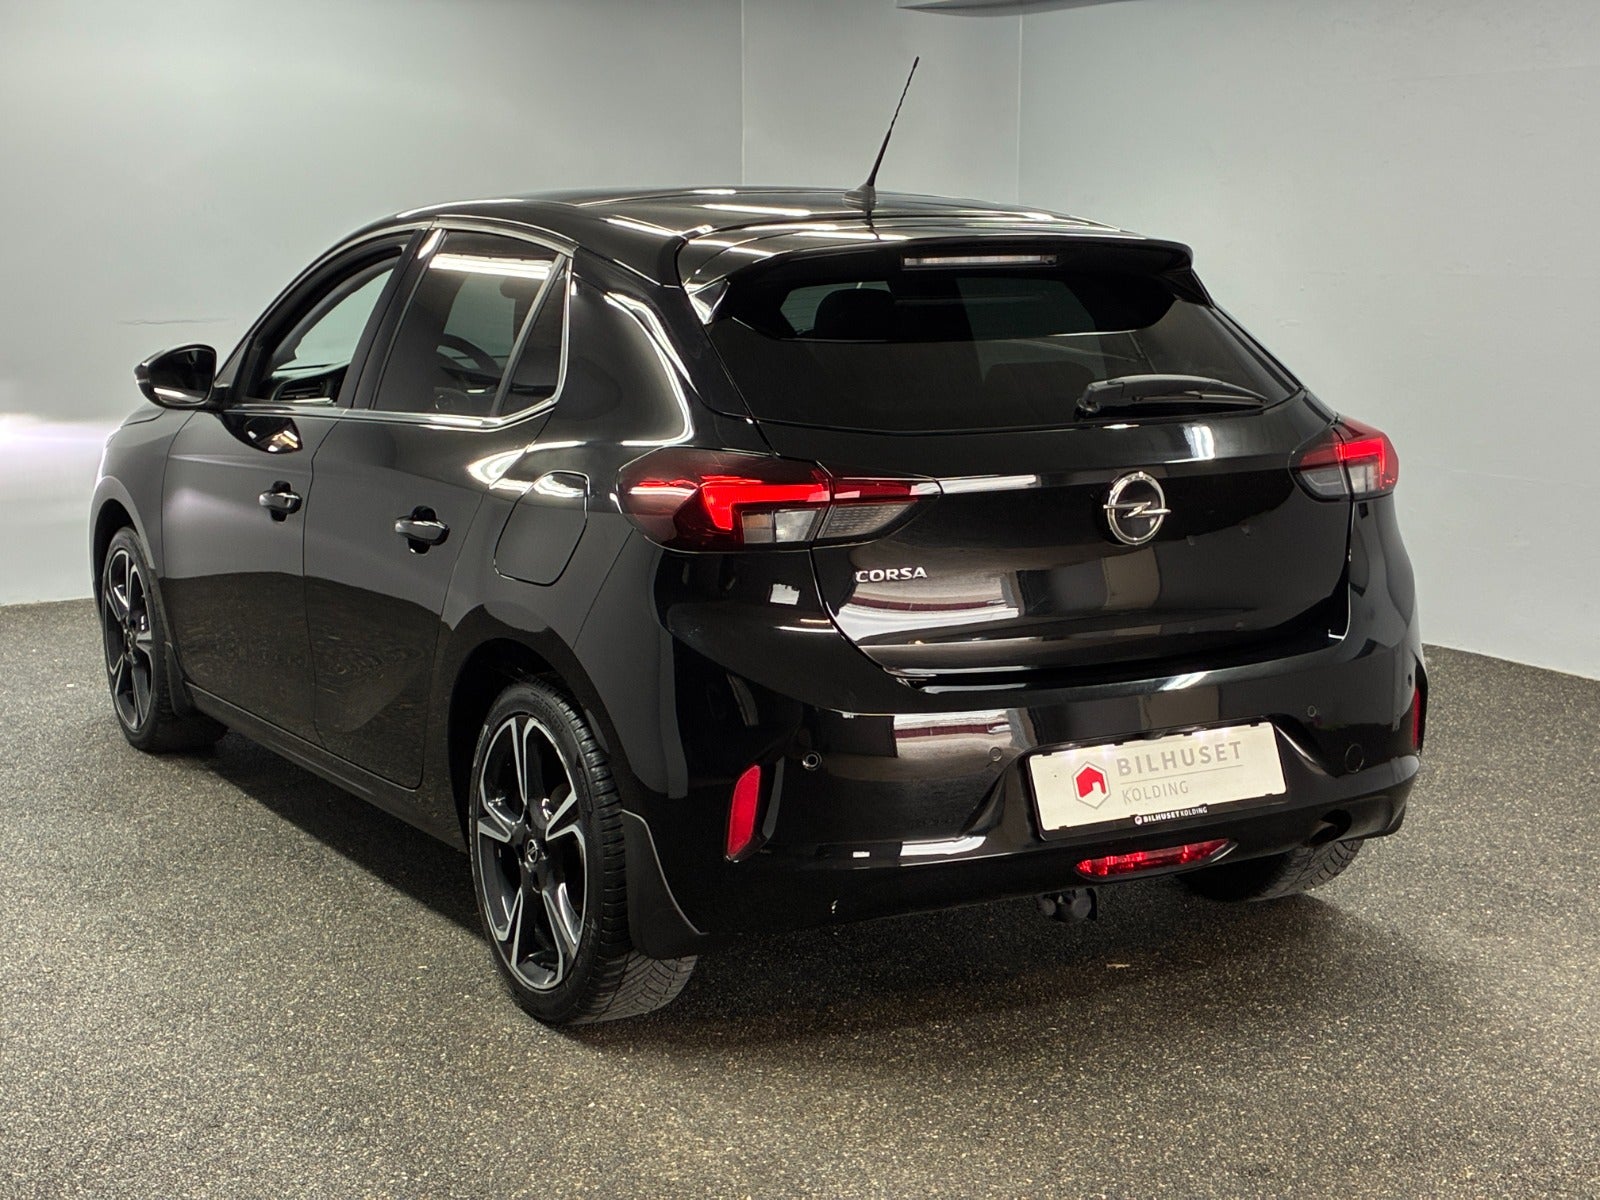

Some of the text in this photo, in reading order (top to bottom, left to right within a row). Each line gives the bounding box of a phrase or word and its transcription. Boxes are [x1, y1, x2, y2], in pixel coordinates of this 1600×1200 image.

[855, 567, 928, 583] CORSA
[1116, 741, 1242, 776] BILHUSET
[1122, 780, 1189, 805] KOLDING
